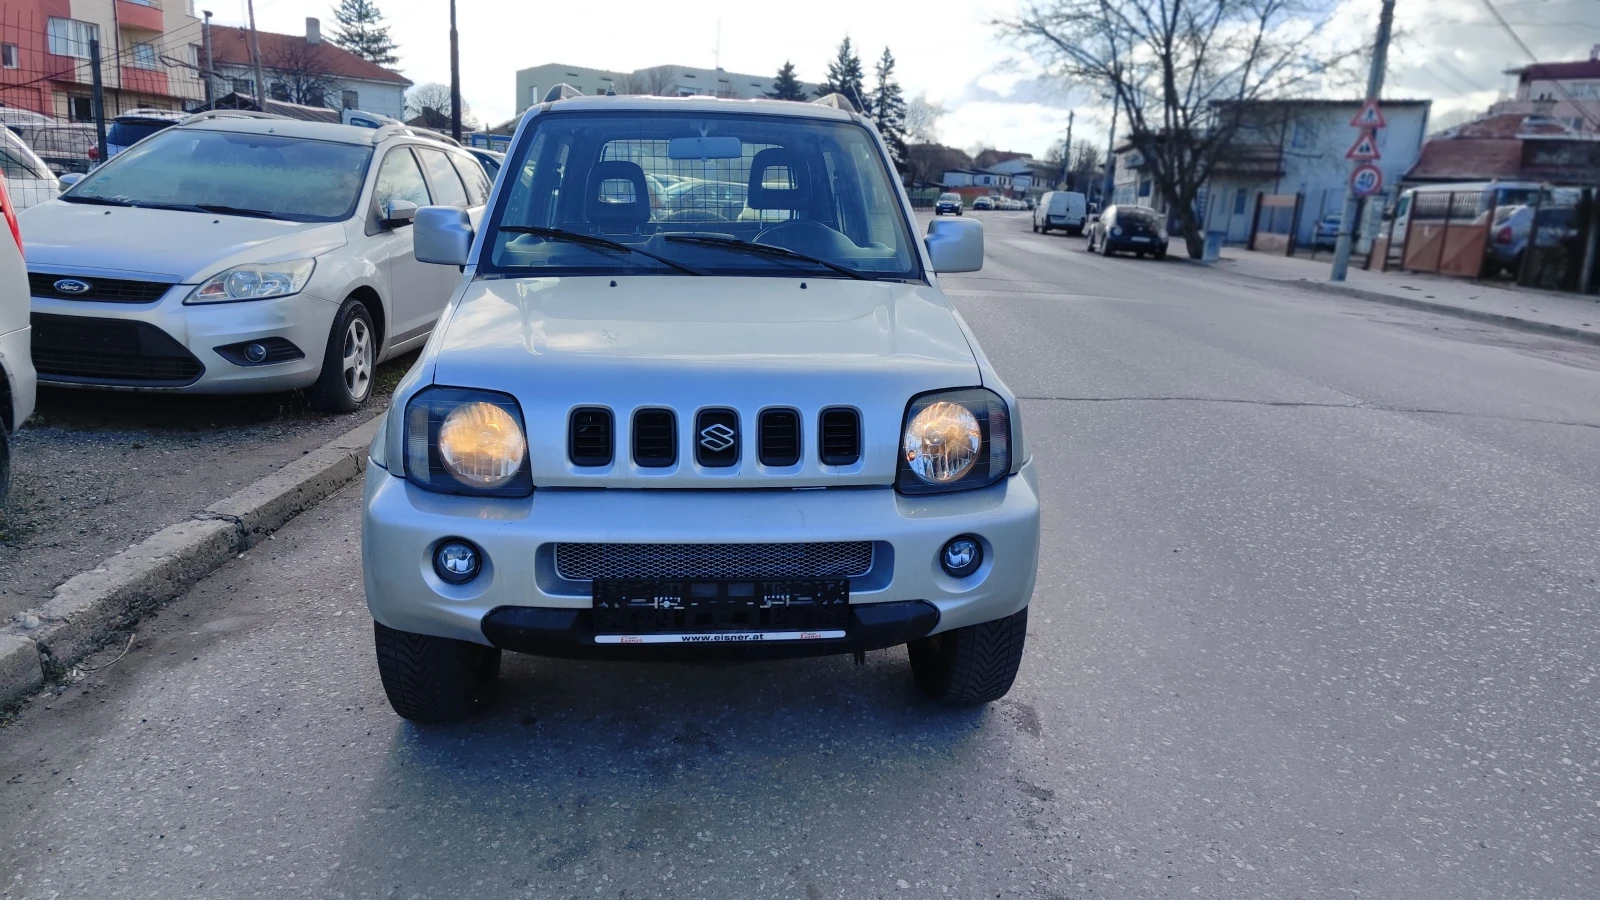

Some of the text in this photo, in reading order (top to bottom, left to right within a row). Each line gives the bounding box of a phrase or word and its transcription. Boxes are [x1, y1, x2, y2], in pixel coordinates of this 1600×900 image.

[1358, 173, 1375, 188] 40
[60, 282, 79, 290] Ford
[681, 633, 764, 642] www.eisner.at
